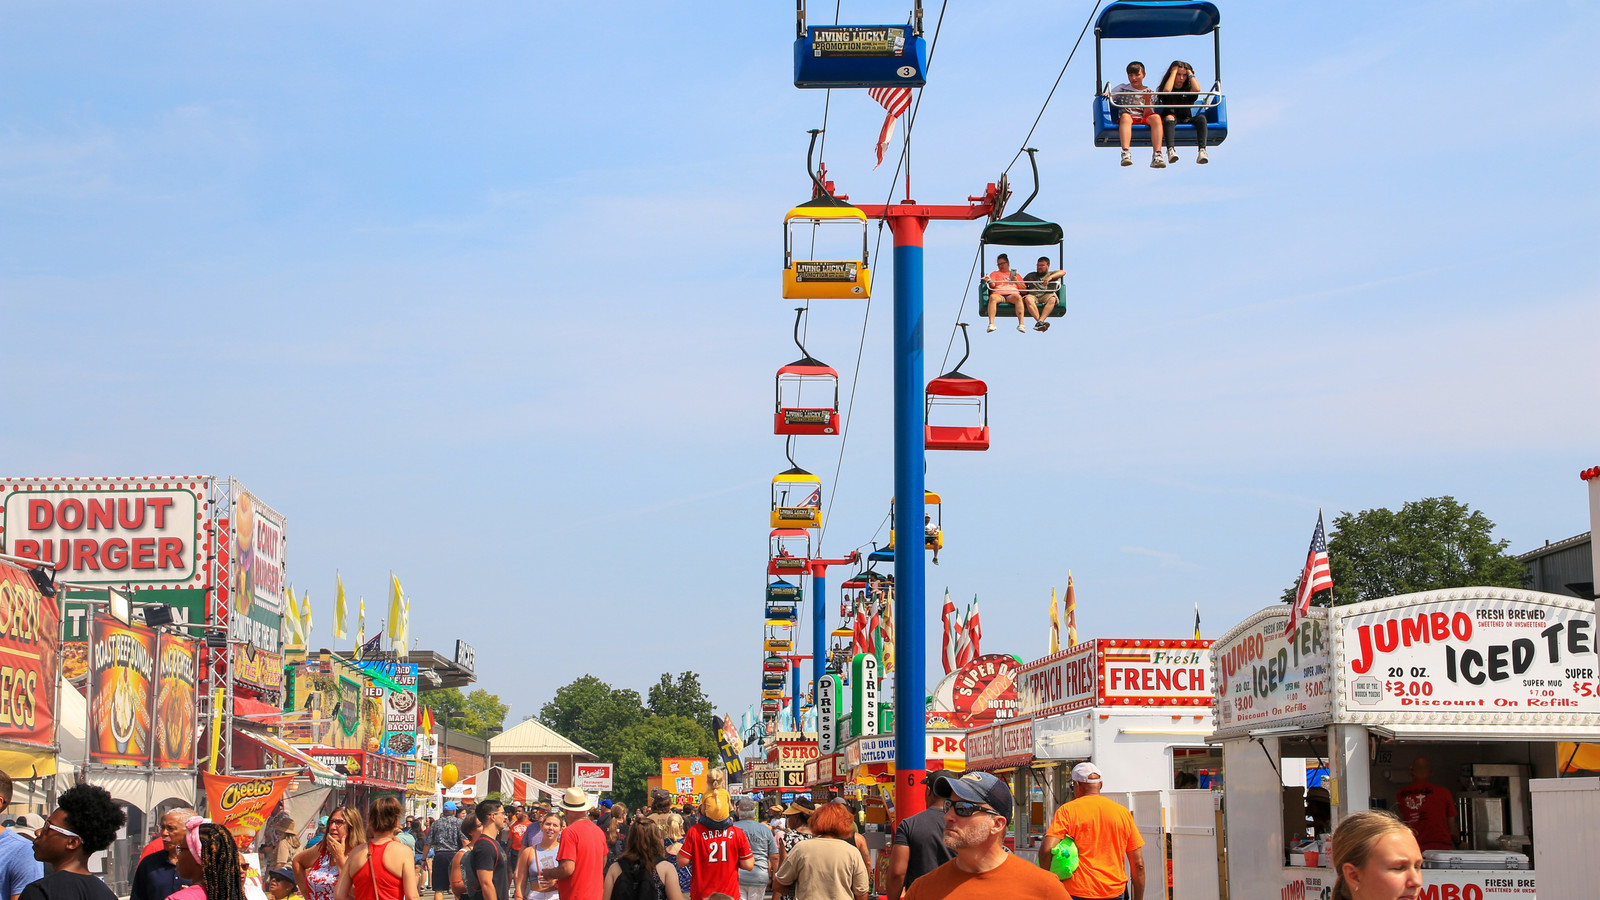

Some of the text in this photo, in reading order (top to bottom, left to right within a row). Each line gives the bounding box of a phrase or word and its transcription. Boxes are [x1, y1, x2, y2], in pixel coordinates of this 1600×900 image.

[815, 31, 886, 42] LIVING LUCKY
[816, 42, 861, 50] PROMOTION
[903, 68, 910, 76] 3
[28, 497, 173, 531] DONUT
[257, 520, 279, 562] DONUT
[15, 537, 184, 570] BURGER
[255, 555, 279, 598] BURGER
[1476, 610, 1545, 620] FRESH BREWED
[1264, 619, 1289, 635] FRESH BREW
[1351, 612, 1473, 674] JUMBO
[95, 635, 153, 682] ROAST BEEF SUNDAE
[1153, 652, 1199, 665] Fresh
[1253, 620, 1324, 698] ICED TEA
[1446, 620, 1597, 685] ICED TE
[396, 666, 411, 675] RED
[1219, 633, 1264, 697] JUMBO
[1303, 666, 1314, 678] SUPER
[1388, 667, 1430, 678] 20 OZ.
[960, 662, 1017, 696] SUPER DO
[1030, 652, 1093, 706] FRENCH FRIES
[1110, 668, 1205, 690] FRENCH
[1565, 668, 1593, 679] SUPER
[1236, 683, 1242, 692] 20
[1305, 680, 1324, 697] $5.00
[1385, 680, 1433, 697] $3.00
[1523, 679, 1563, 687] SUPER MUG
[988, 700, 1018, 708] HOT DO
[1234, 695, 1253, 711] $3.00
[1401, 698, 1579, 706] Discount On Refills
[820, 680, 831, 750] DiRusso's
[996, 709, 1014, 718] ON A
[1237, 710, 1269, 722] Discount
[1272, 707, 1282, 715] On
[1285, 703, 1307, 713] Refills
[862, 740, 876, 750] COLD
[1020, 727, 1032, 750] FRIES
[717, 728, 742, 775] ATM
[782, 747, 822, 758] STRO
[861, 751, 886, 761] BOTTLED
[679, 780, 692, 790] ICEE
[908, 773, 915, 786] 6
[221, 779, 273, 810] Cheetos
[708, 841, 727, 862] 21
[1485, 879, 1513, 887] FRESH
